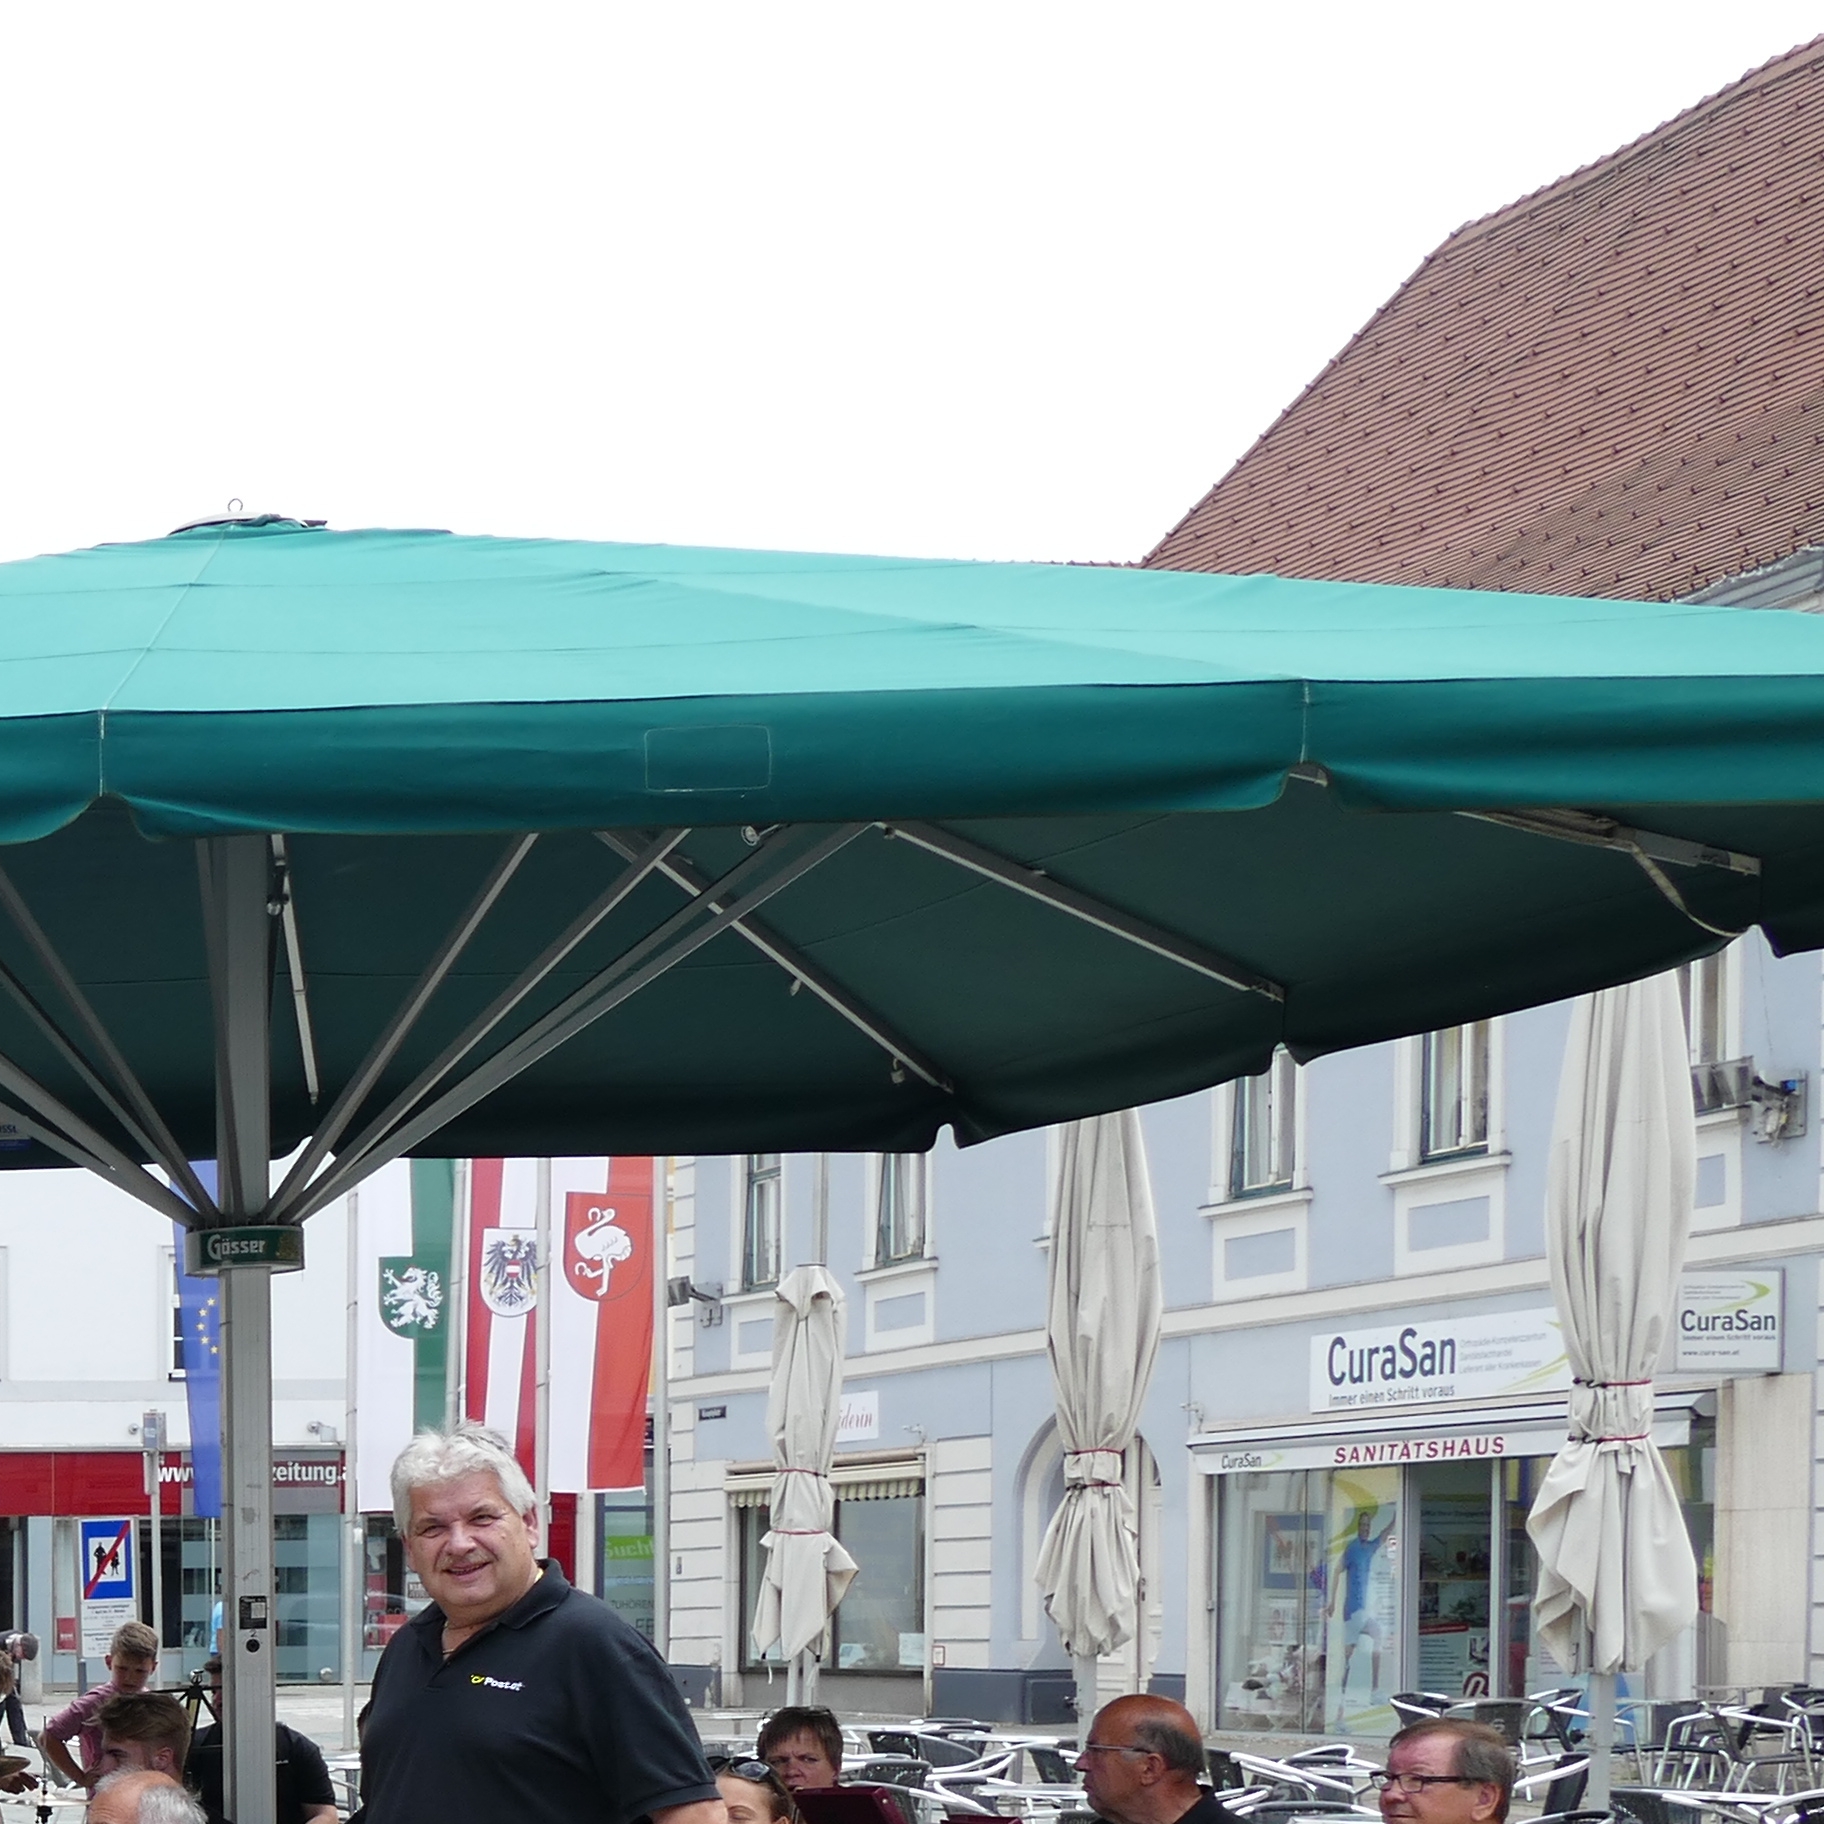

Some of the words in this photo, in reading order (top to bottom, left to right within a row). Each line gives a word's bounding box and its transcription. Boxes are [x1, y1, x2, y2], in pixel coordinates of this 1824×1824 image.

[207, 1234, 266, 1260] Gösser
[1681, 1309, 1775, 1332] CuraSan
[1328, 1328, 1456, 1386] CuraSan
[1387, 1387, 1420, 1402] Schritt
[1422, 1385, 1455, 1399] voraus
[1221, 1453, 1262, 1469] CuraSan
[1334, 1437, 1504, 1464] SANITÄTSHAUS
